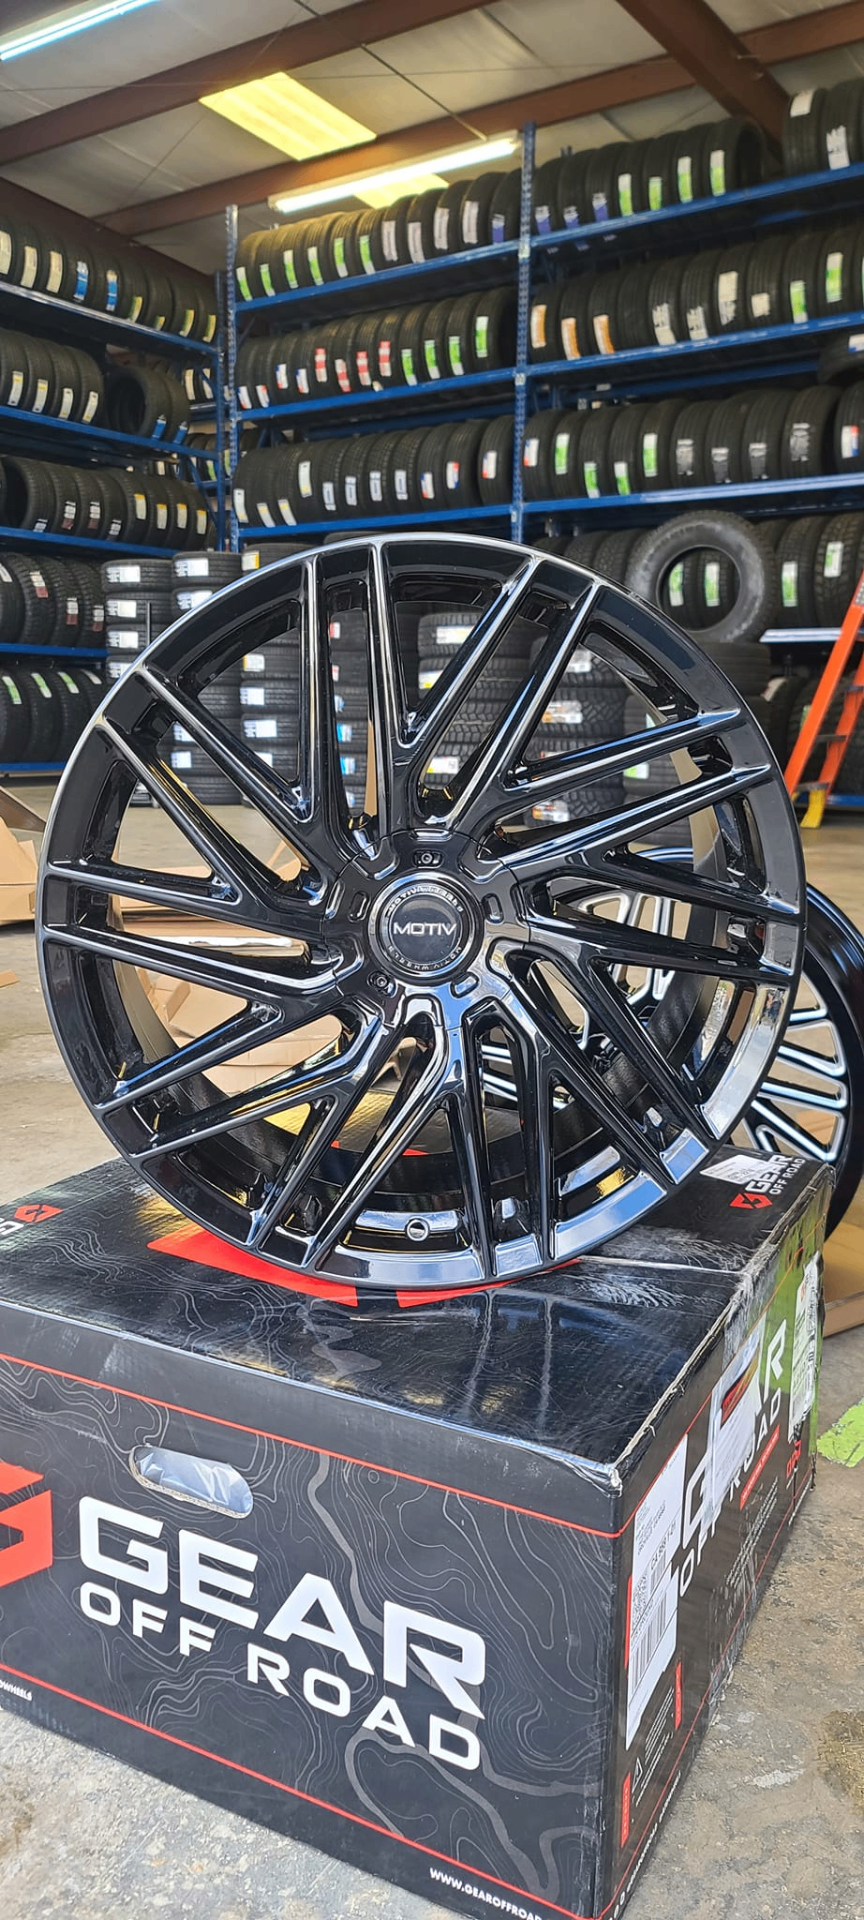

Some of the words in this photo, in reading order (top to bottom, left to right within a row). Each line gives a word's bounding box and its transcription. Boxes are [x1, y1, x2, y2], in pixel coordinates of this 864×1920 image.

[393, 921, 457, 936] MOTIV
[745, 1154, 794, 1194] GEAR
[768, 1177, 788, 1195] OFF
[782, 1158, 805, 1179] ROAD
[79, 1496, 486, 1719] GEAR
[80, 1581, 217, 1657] OFF
[246, 1643, 481, 1771] ROAD
